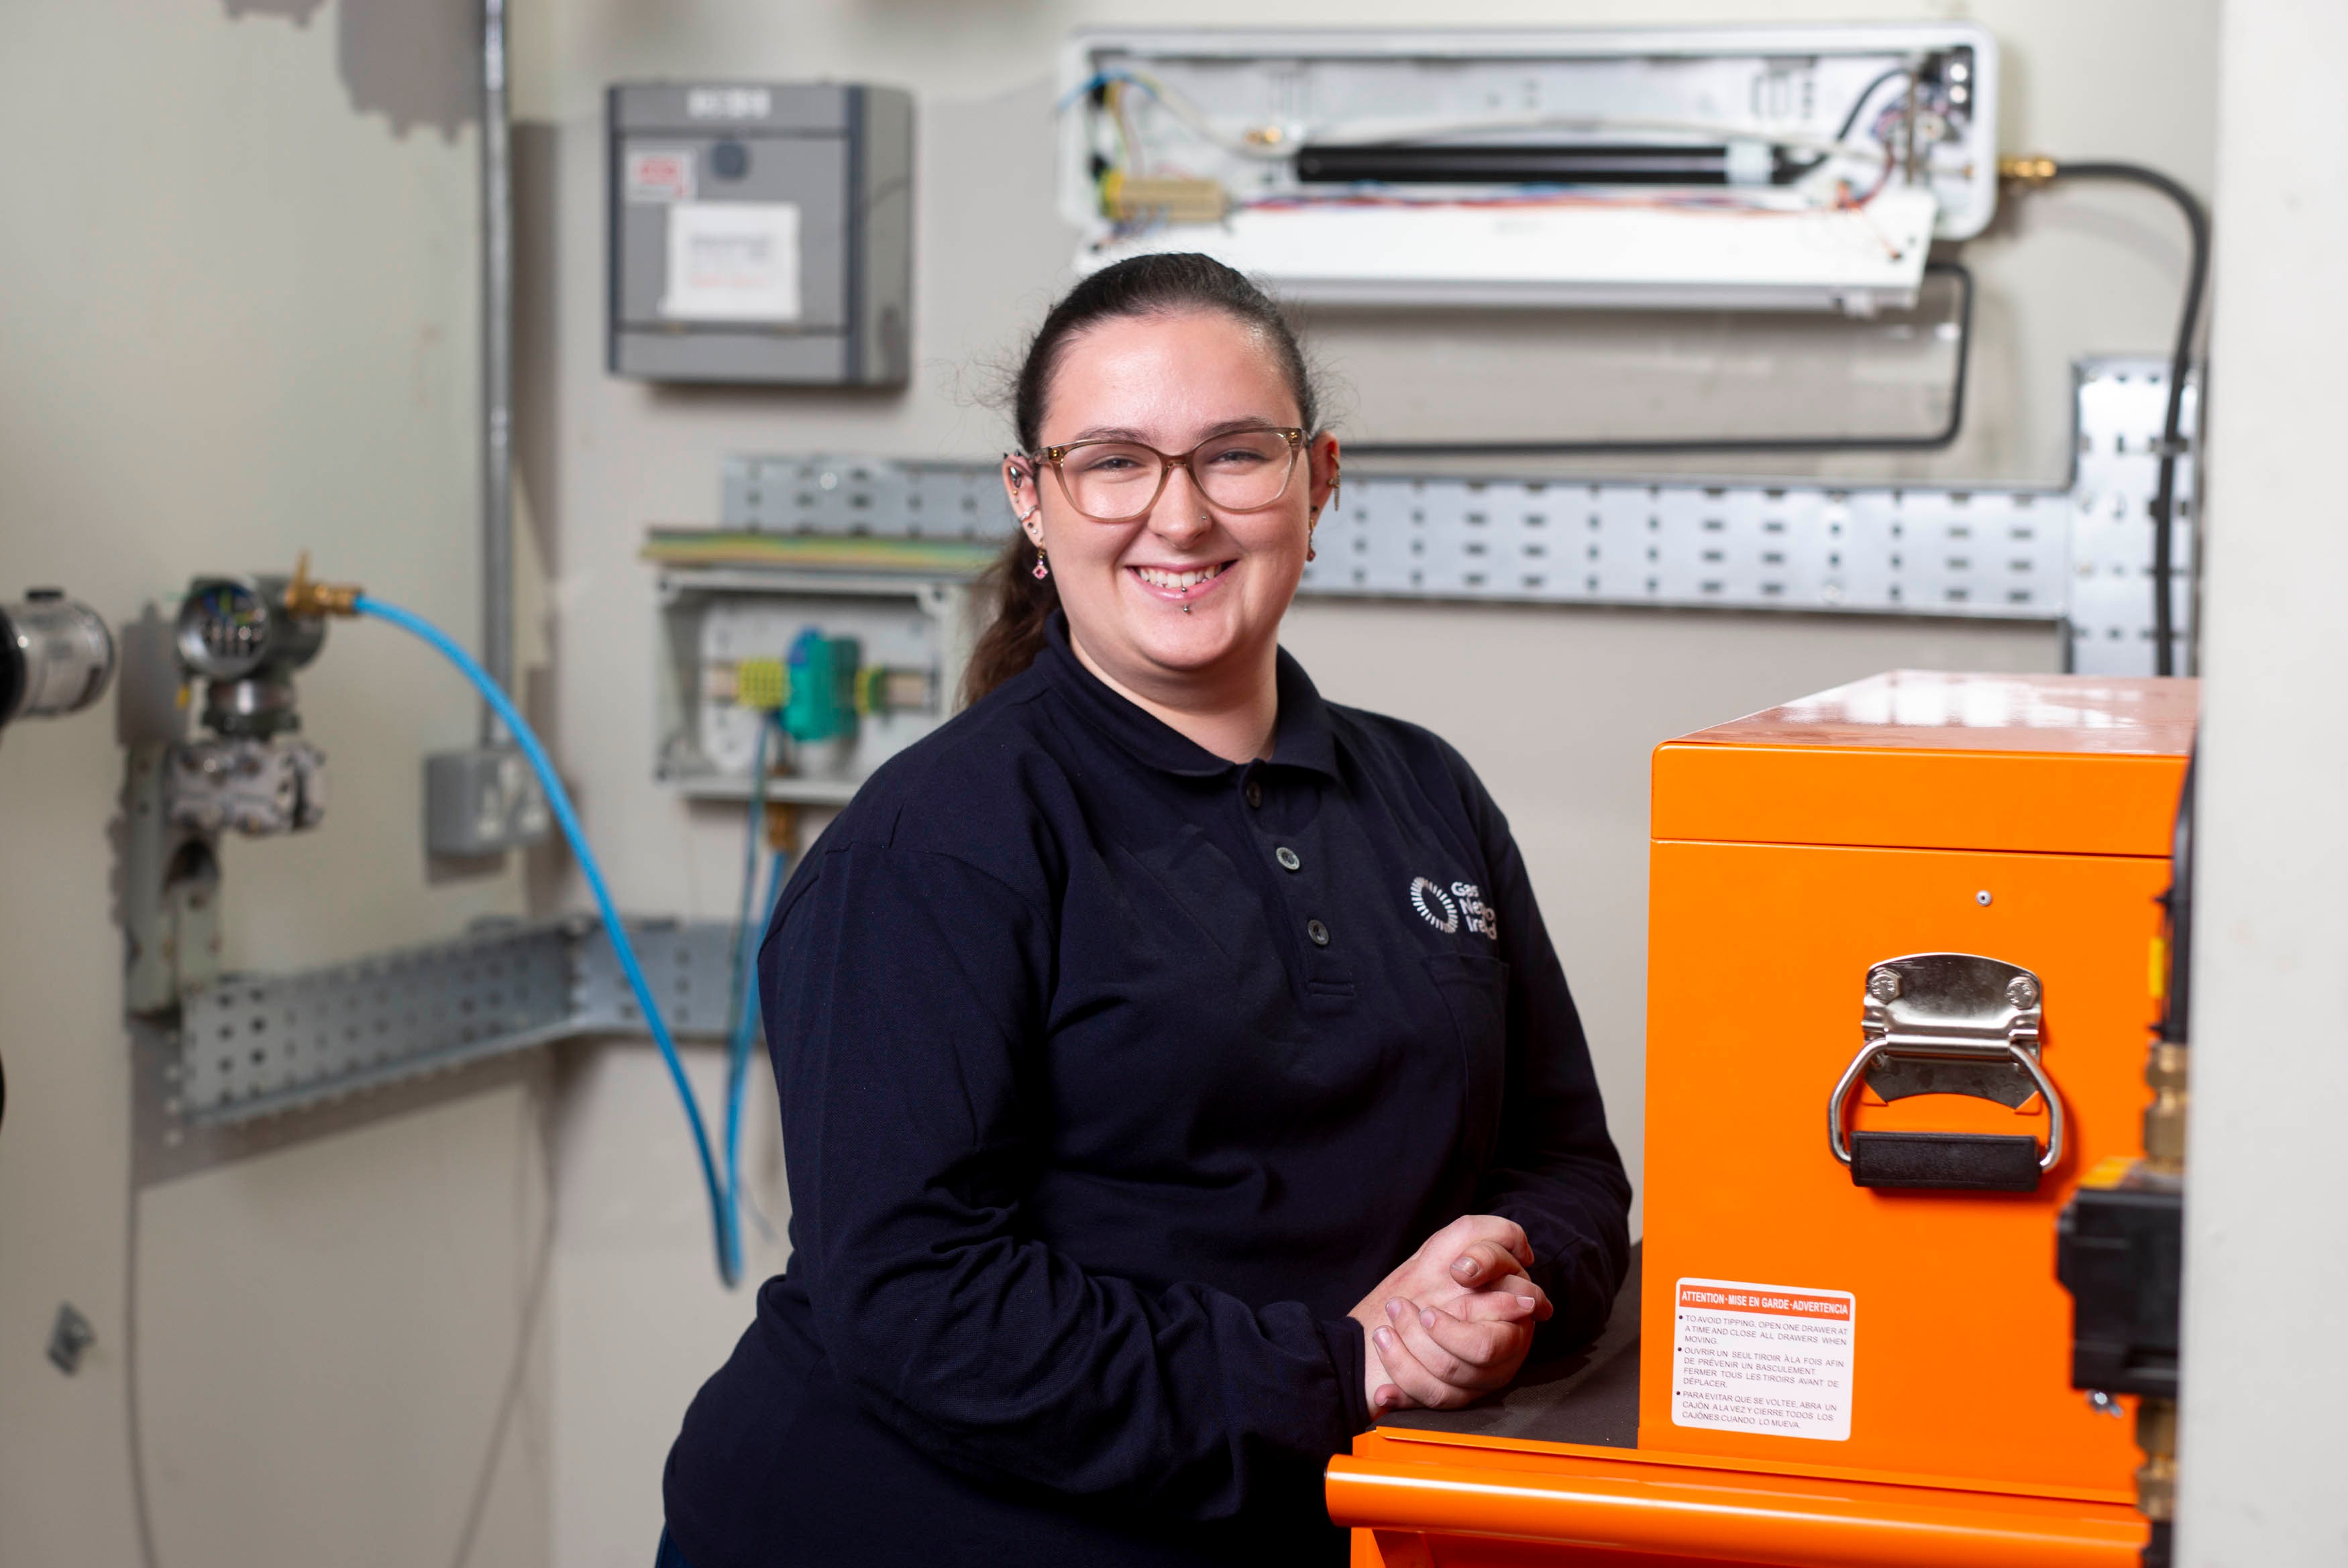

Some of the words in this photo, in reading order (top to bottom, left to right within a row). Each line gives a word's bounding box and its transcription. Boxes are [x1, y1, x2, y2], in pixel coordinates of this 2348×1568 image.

[1451, 882, 1479, 897] Gas
[1750, 1296, 1759, 1306] EN
[1698, 1316, 1721, 1325] AVOID
[1759, 1321, 1782, 1329] OPEN
[1783, 1323, 1799, 1331] ONE
[1802, 1325, 1838, 1334] DRAWER
[1729, 1329, 1756, 1337] CLOSE
[1778, 1333, 1818, 1343] DRAWERS
[1822, 1337, 1846, 1345] WHEN
[1685, 1347, 1715, 1355] OUVRIR
[1717, 1349, 1728, 1357] UN
[1754, 1353, 1780, 1361] TIROIR
[1803, 1357, 1822, 1365] FOIS
[1698, 1357, 1738, 1367] PRÉVENIR
[1684, 1368, 1717, 1376] FERMER
[1721, 1371, 1742, 1379] TOUS
[1764, 1374, 1795, 1383] TIROIRS
[1799, 1378, 1823, 1386] AVANT
[1683, 1391, 1703, 1399] PARA
[1705, 1393, 1733, 1402] EVITAR
[1721, 1414, 1755, 1423] CUANDO
[1754, 1408, 1783, 1416] CIERRE
[1786, 1410, 1813, 1419] TODOS
[1817, 1412, 1833, 1420] LOS
